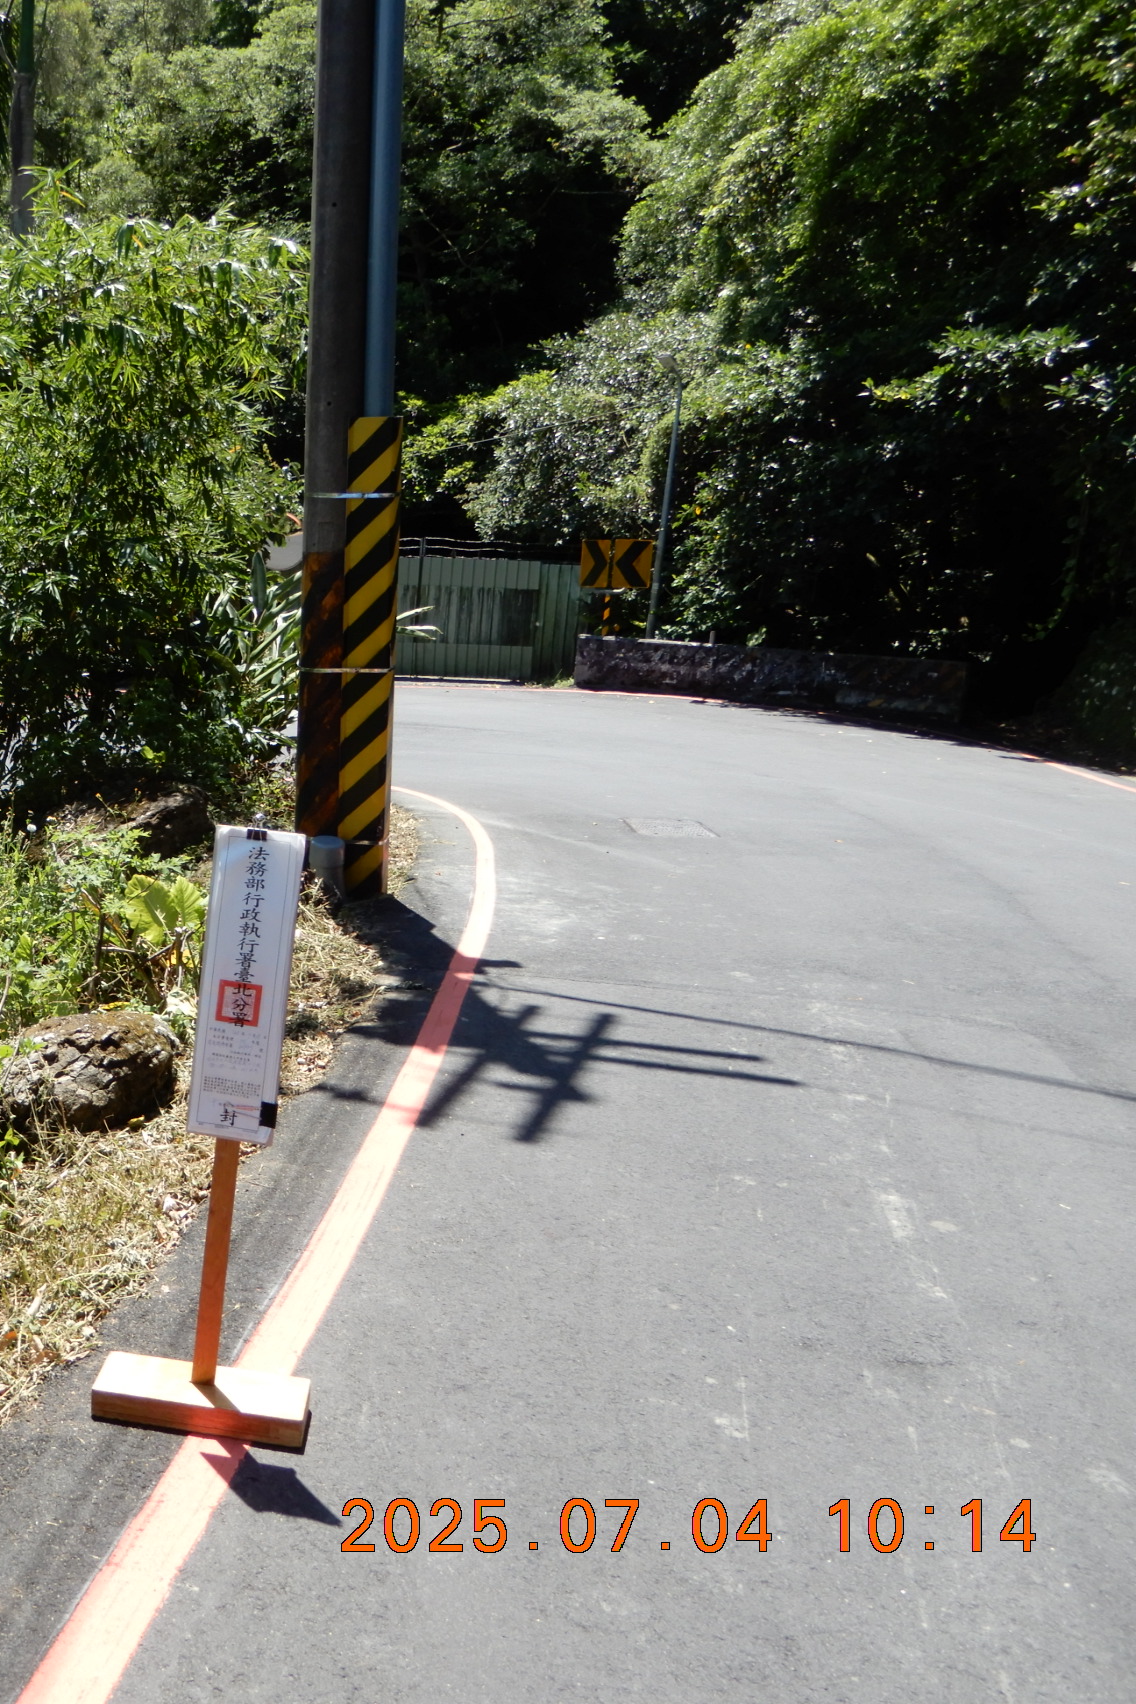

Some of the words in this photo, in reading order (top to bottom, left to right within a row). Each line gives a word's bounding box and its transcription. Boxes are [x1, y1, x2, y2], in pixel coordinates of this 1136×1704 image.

[229, 846, 270, 1028] 法務部行政執行署臺北分署
[220, 1108, 238, 1126] 封
